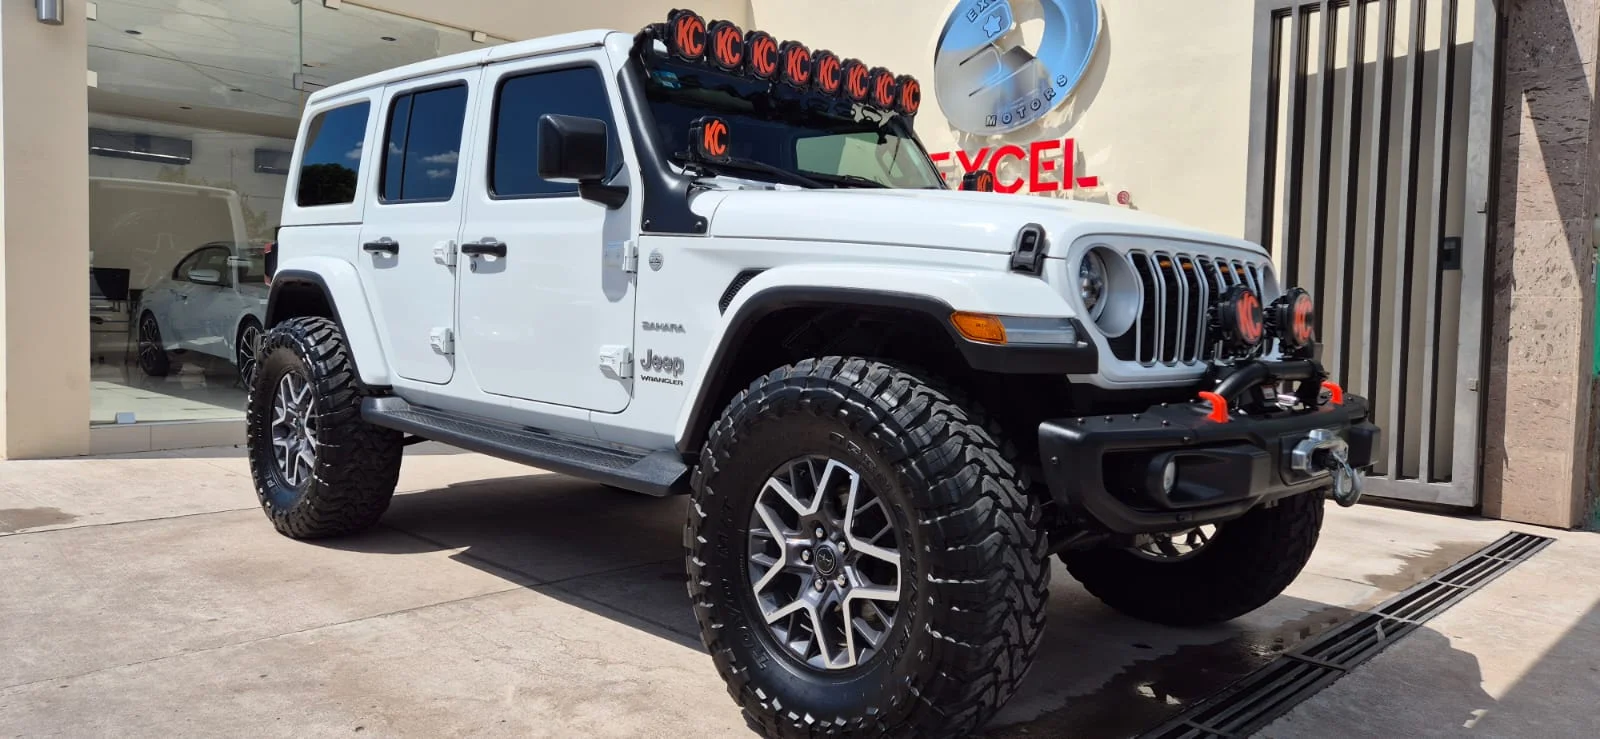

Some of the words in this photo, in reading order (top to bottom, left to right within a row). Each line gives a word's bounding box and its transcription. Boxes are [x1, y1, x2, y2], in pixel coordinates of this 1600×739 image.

[966, 0, 997, 22] EX
[677, 16, 703, 56] KC
[716, 27, 740, 65] KC
[753, 37, 776, 74] KC
[787, 47, 809, 82] KC
[819, 56, 839, 91] KC
[848, 64, 868, 98] KC
[875, 72, 894, 105] KC
[902, 80, 919, 112] KC
[985, 74, 1068, 127] MOTORS
[704, 119, 727, 156] KC
[641, 321, 686, 334] SAHARA
[1236, 290, 1262, 340] KC
[640, 349, 684, 378] Jeep
[640, 375, 684, 386] WRANGLER
